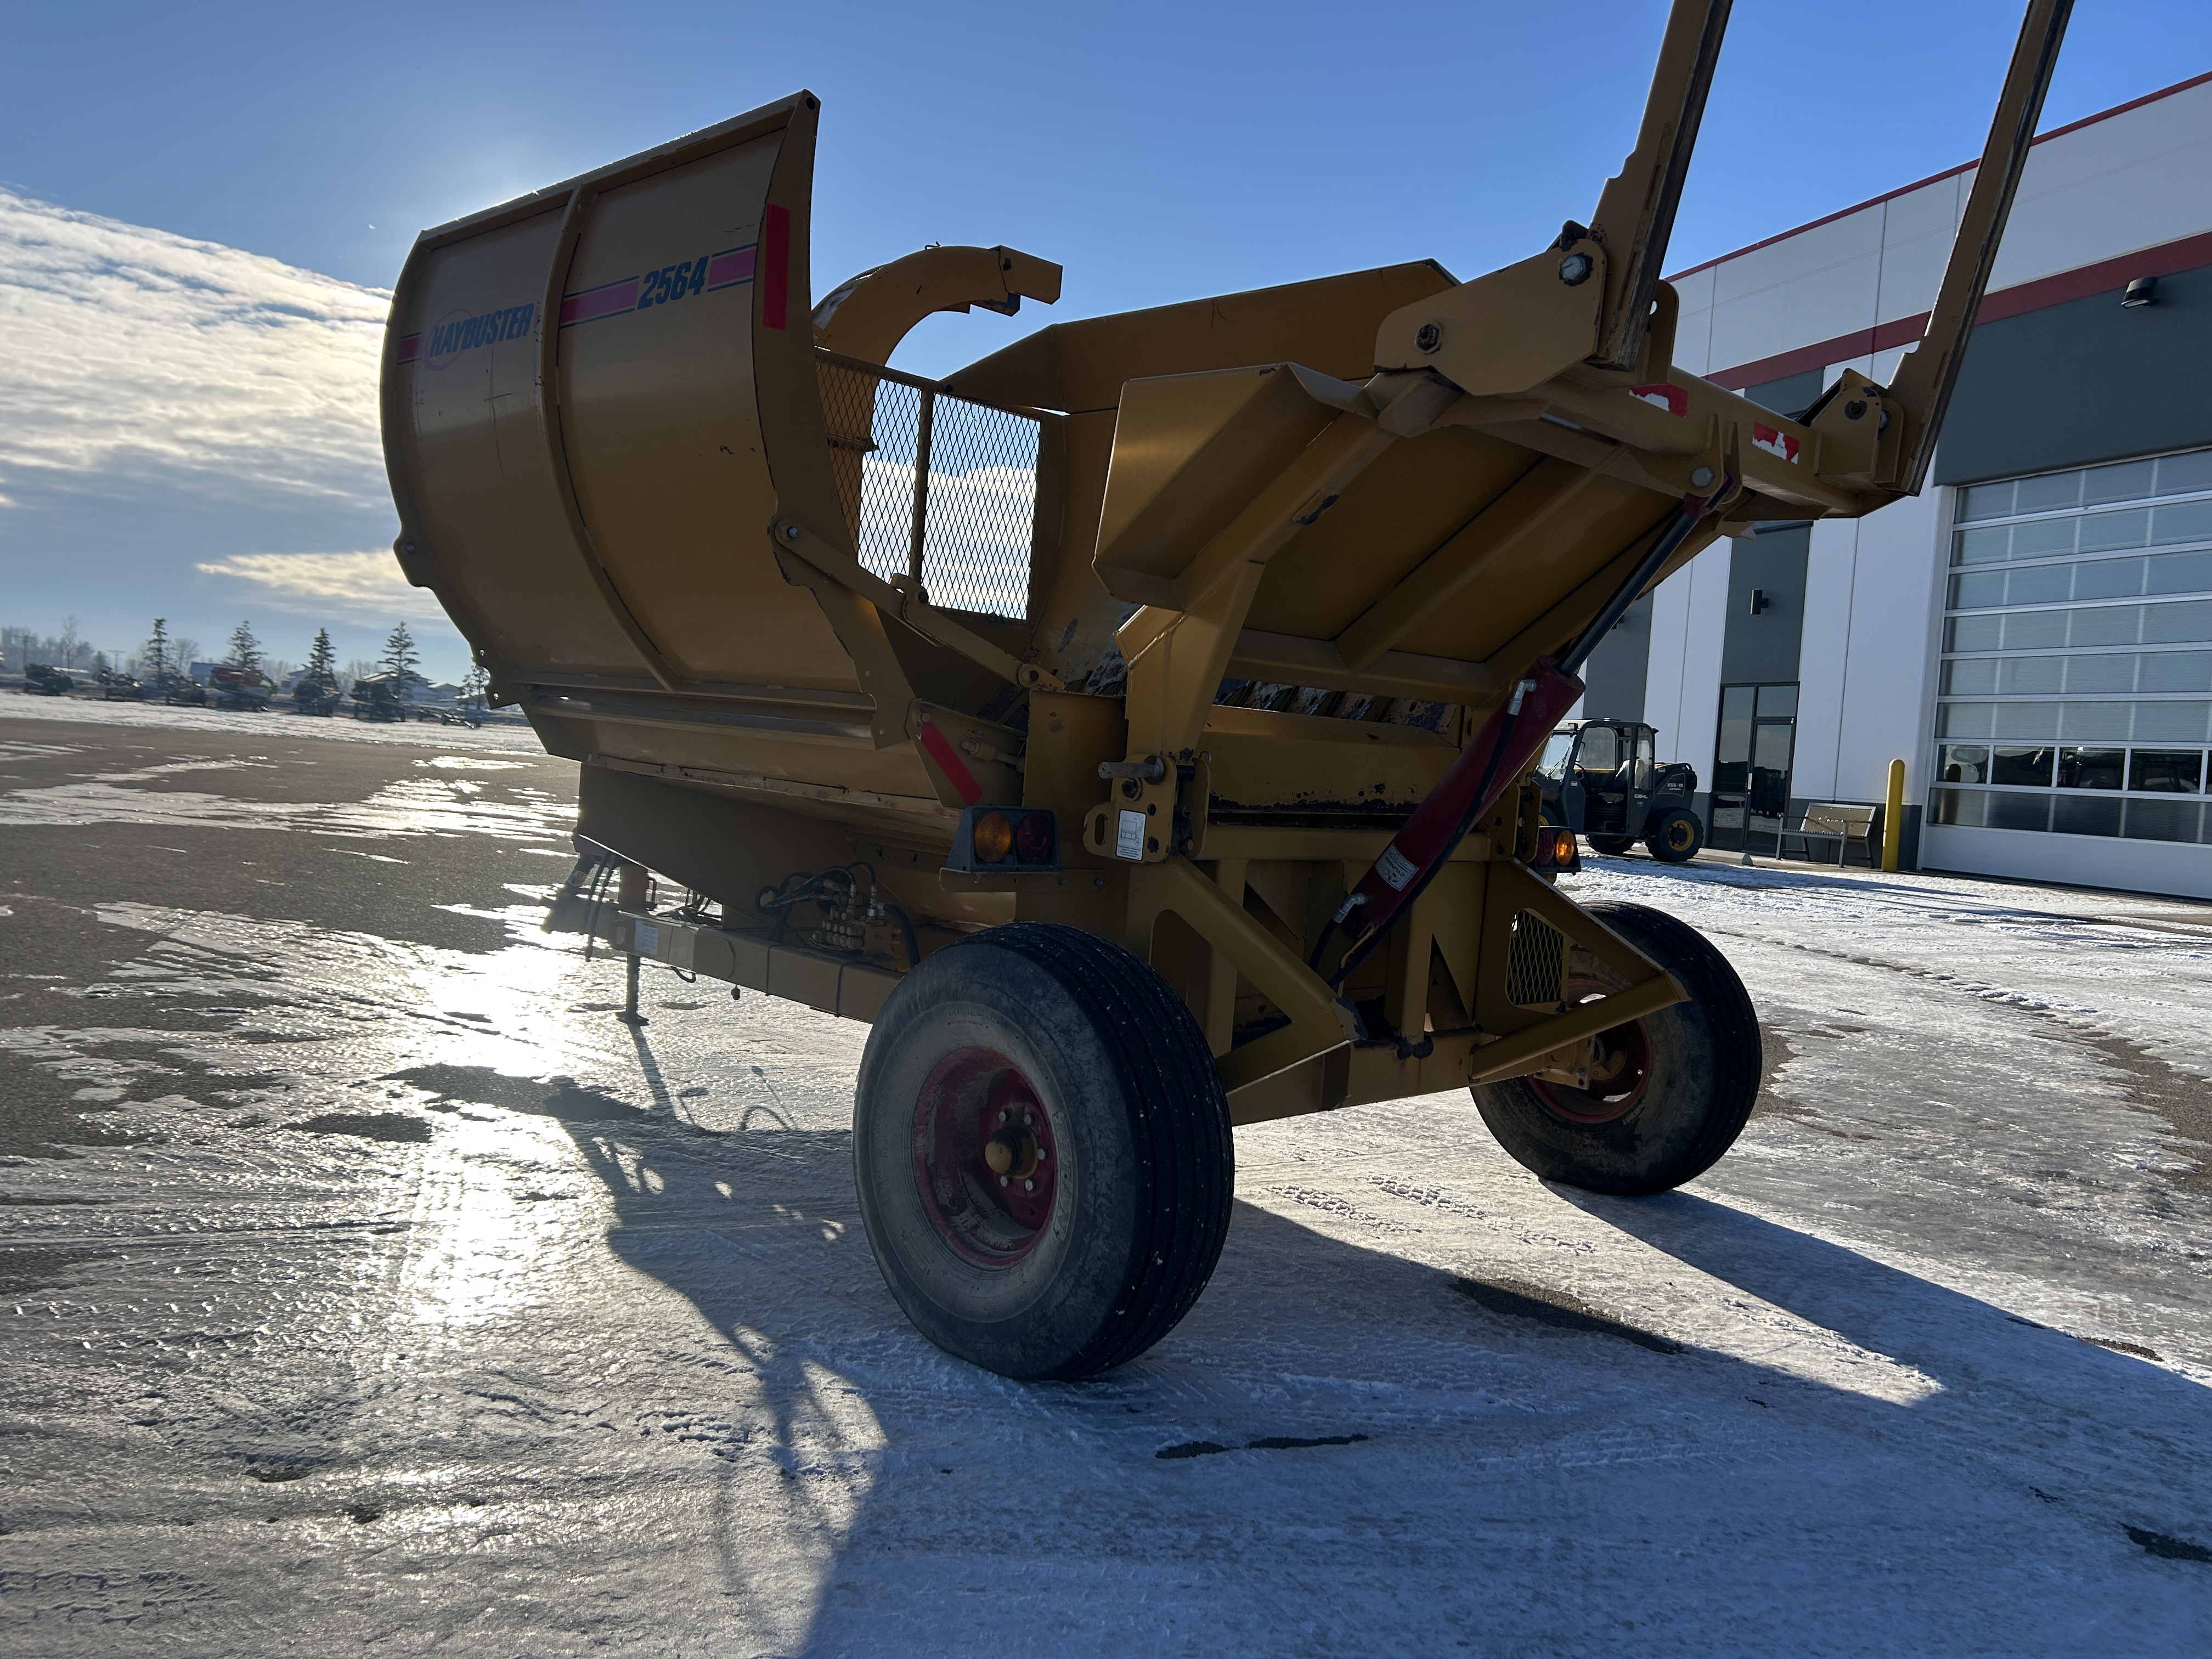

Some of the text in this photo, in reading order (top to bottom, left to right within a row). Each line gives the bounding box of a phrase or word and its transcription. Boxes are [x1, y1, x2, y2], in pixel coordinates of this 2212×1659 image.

[637, 255, 709, 310] 2564
[429, 303, 535, 357] HAYBUSTER
[1384, 856, 1404, 877] CYLINDER
